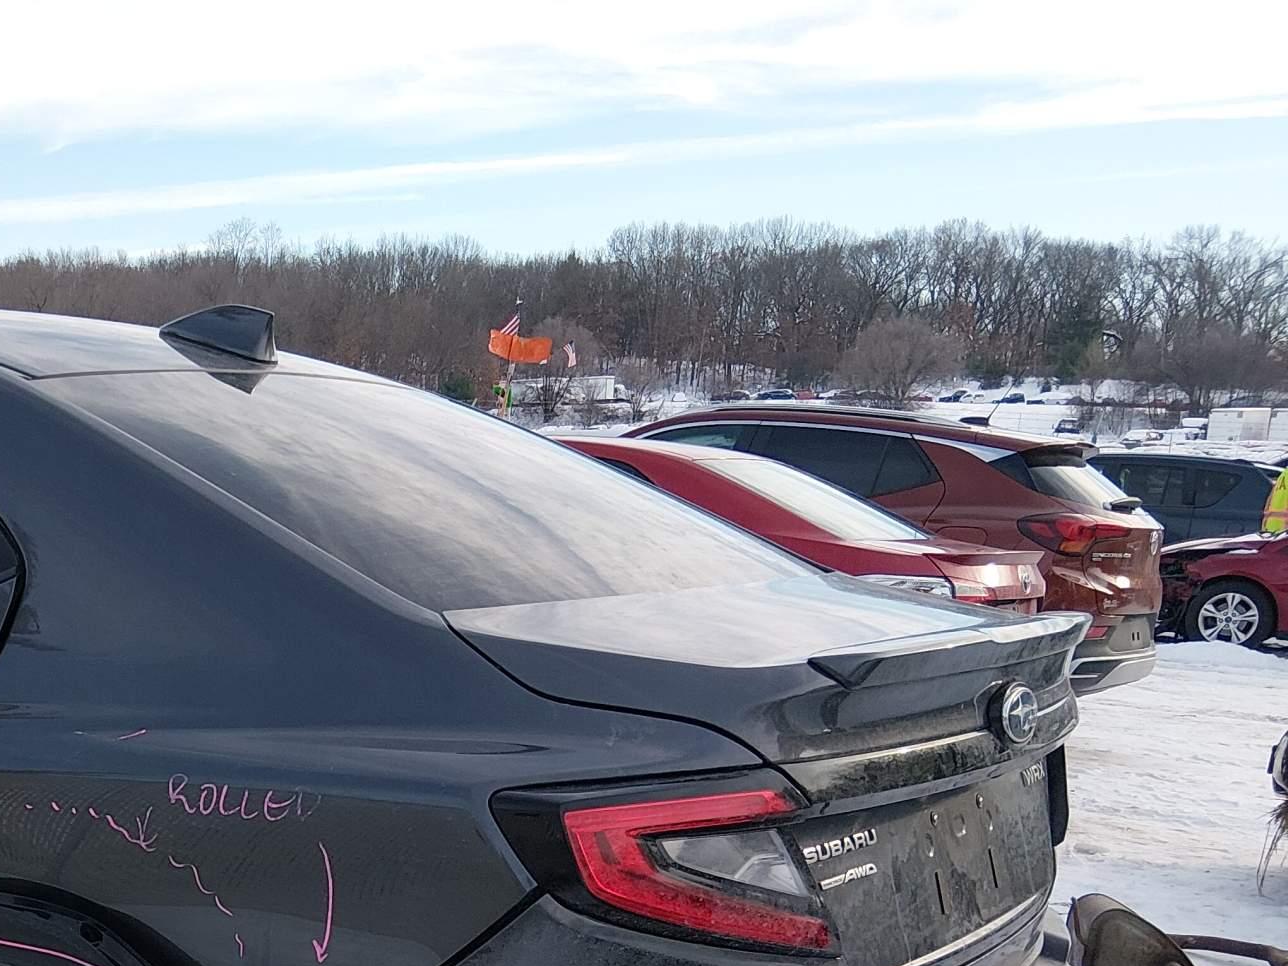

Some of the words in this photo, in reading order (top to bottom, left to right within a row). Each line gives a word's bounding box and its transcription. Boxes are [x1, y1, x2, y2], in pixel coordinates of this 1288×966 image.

[1021, 761, 1046, 787] WRX
[168, 773, 322, 823] ROLLED
[802, 828, 879, 865] SUBARU
[844, 863, 878, 884] AWD
